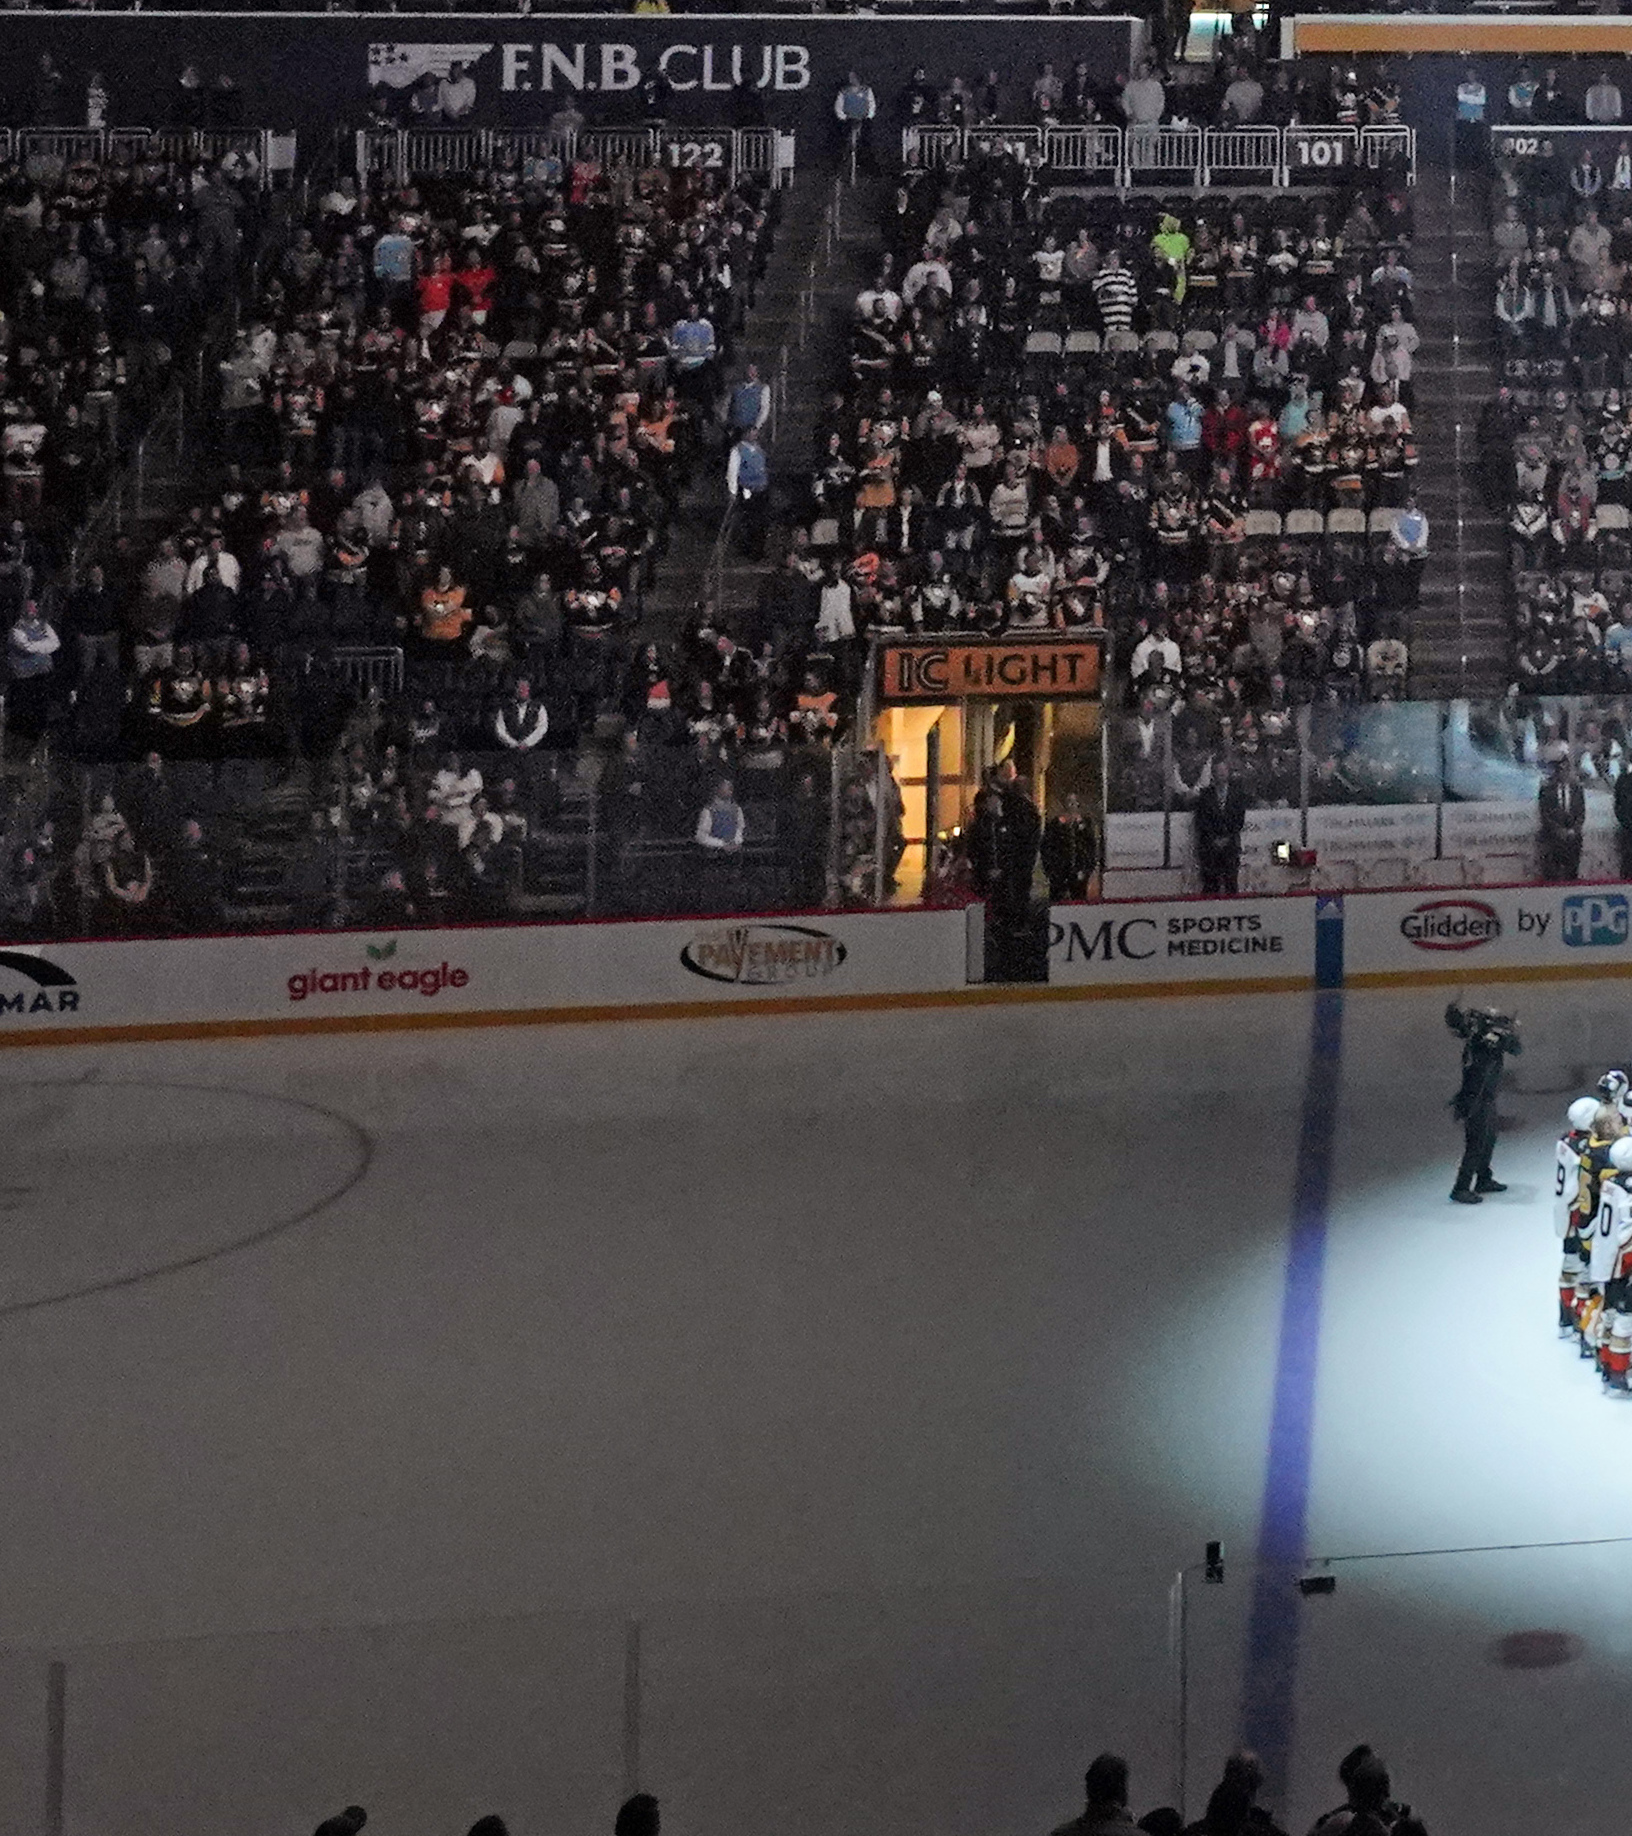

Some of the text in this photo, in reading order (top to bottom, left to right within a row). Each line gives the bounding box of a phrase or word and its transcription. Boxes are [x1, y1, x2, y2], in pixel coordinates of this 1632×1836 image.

[668, 142, 725, 168] 122
[1296, 140, 1343, 166] 101
[898, 651, 1086, 692] IC LIGHT
[1167, 914, 1262, 935] SPORTS
[1400, 913, 1504, 940] Glidden
[1517, 907, 1551, 937] by
[1167, 935, 1283, 957] MEDICINE
[287, 961, 470, 1002] giant eagle
[0, 989, 81, 1014] MAR
